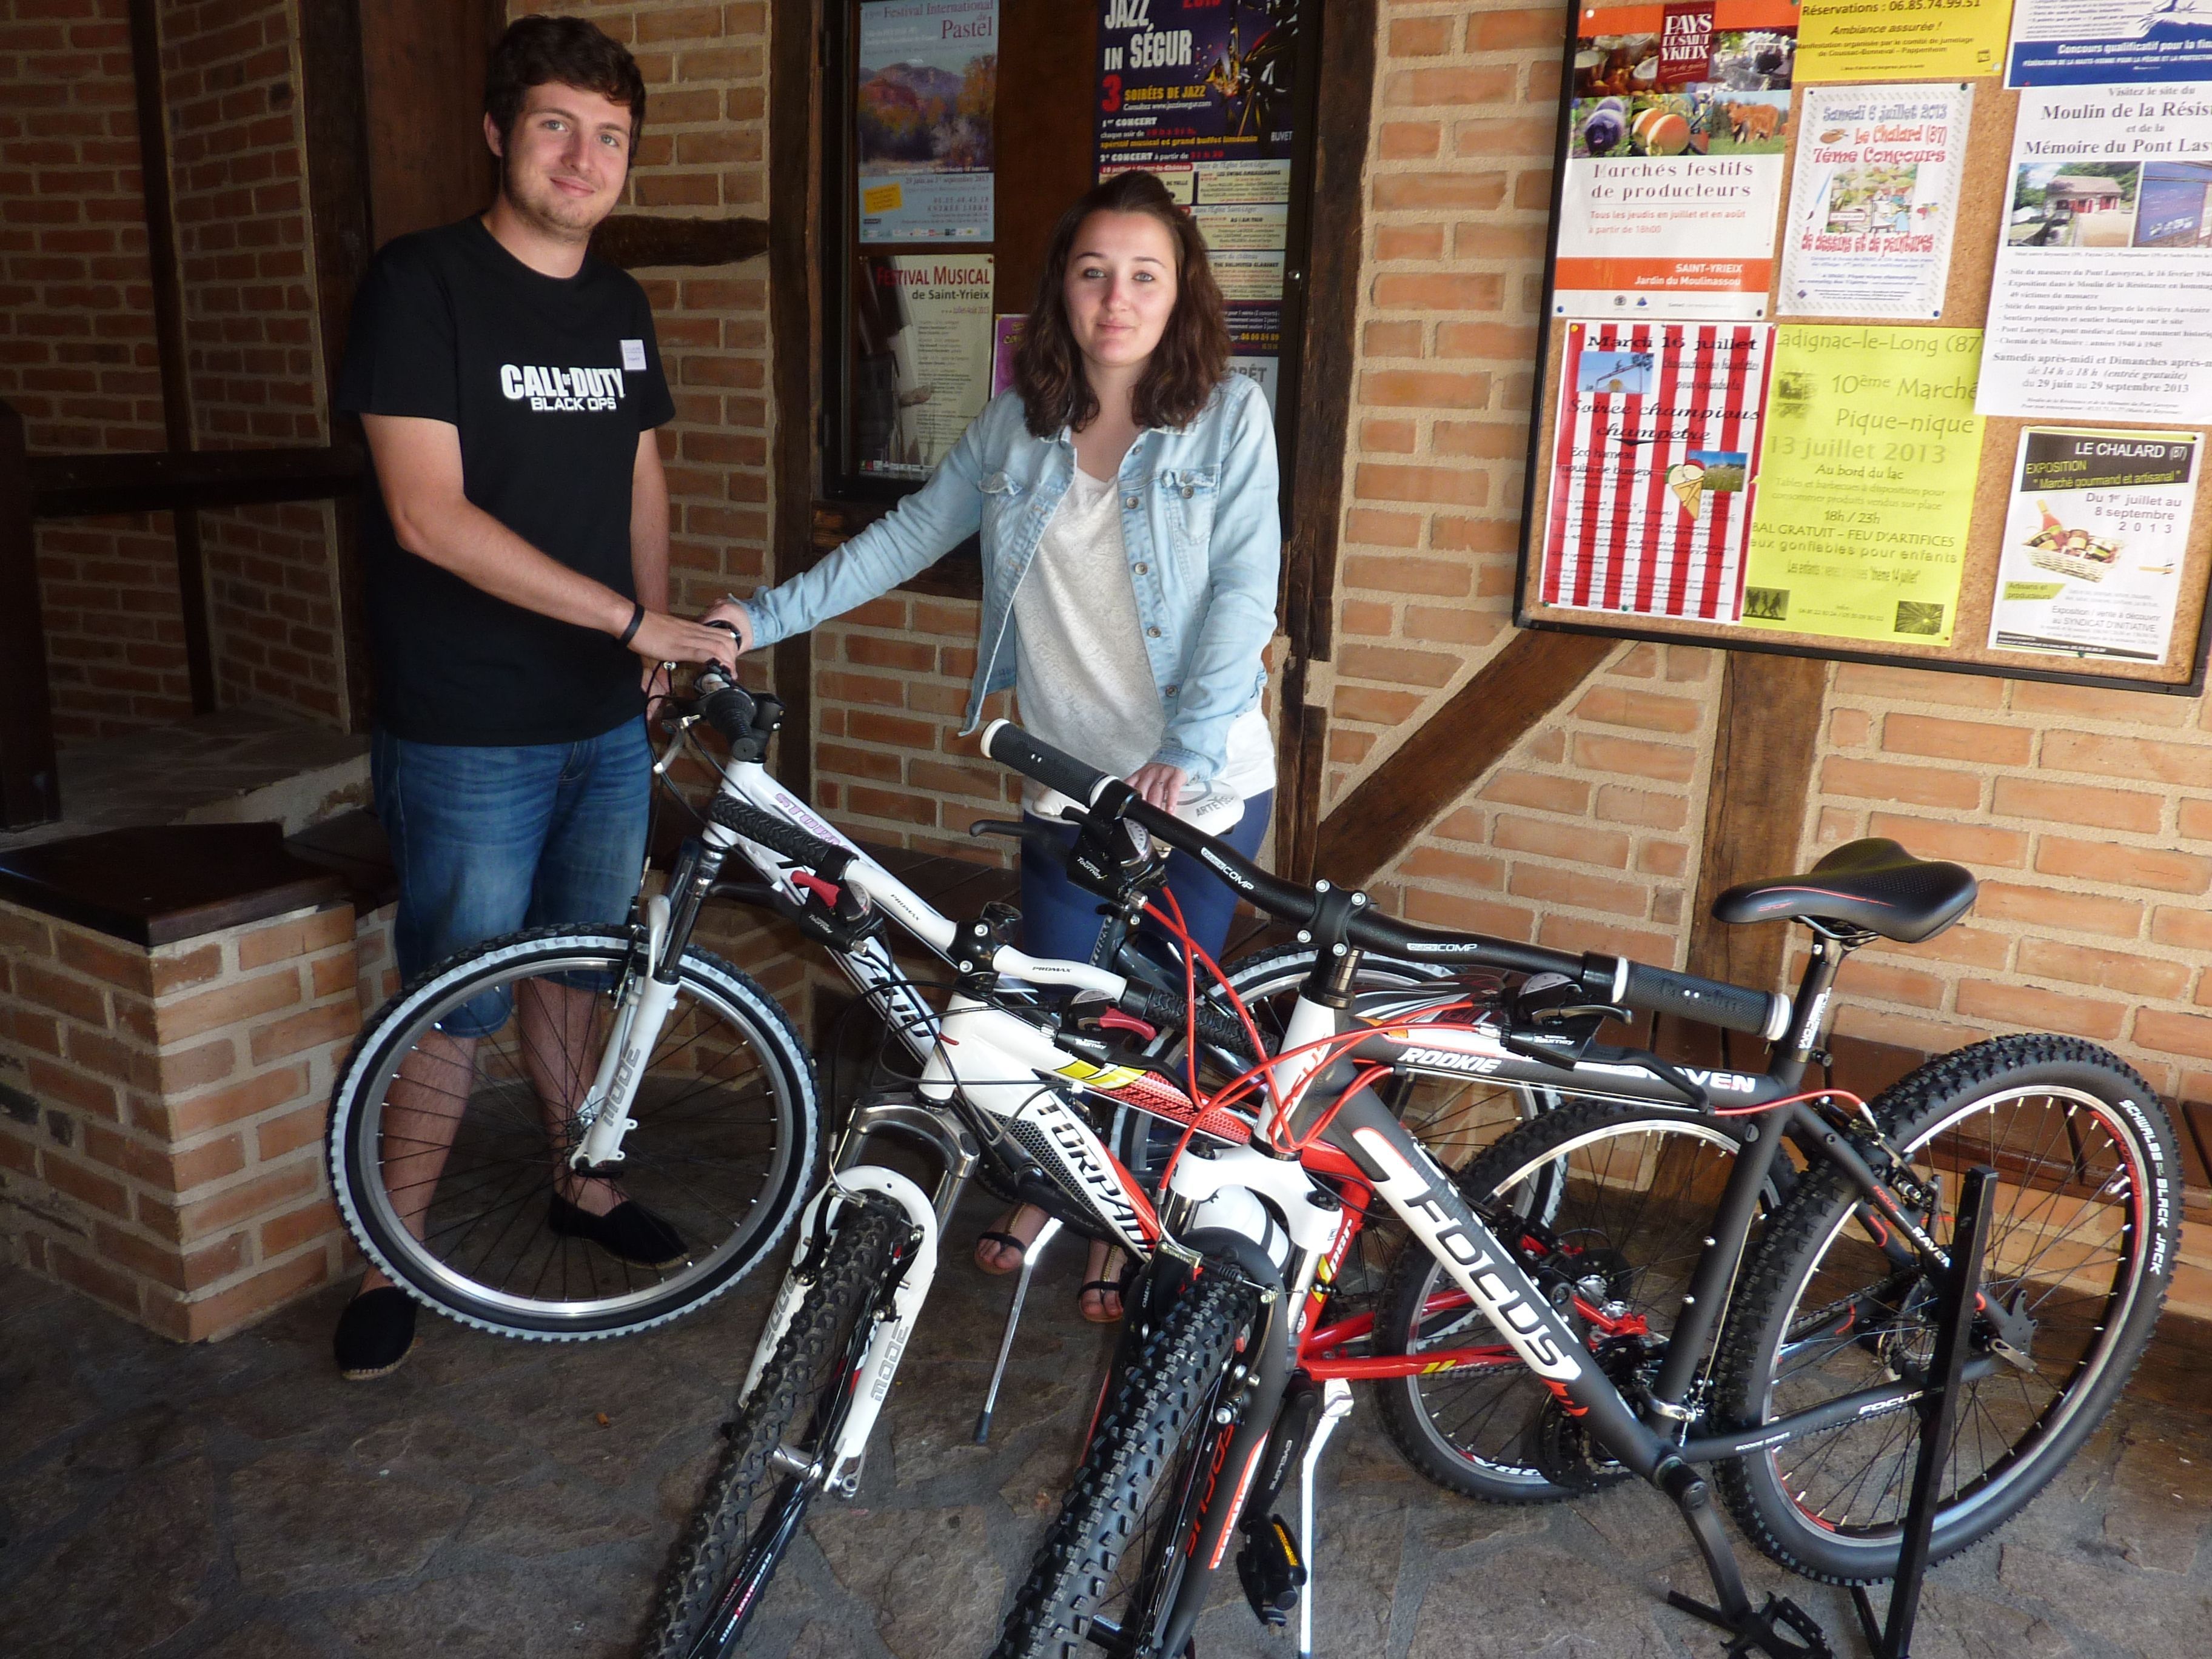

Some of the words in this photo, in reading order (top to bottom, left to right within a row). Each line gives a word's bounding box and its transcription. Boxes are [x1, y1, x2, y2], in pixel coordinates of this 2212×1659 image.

[883, 4, 923, 18] Festival
[927, 0, 993, 15] International
[1104, 0, 1150, 29] JAZZ
[1802, 2, 1878, 16] Réservations
[942, 17, 993, 40] Pastel
[1665, 14, 1712, 35] PAYS
[1830, 24, 1885, 36] Ambiance
[1891, 22, 1935, 33] assurée
[1104, 47, 1123, 70] IN
[1130, 22, 1192, 69] SÉGUR
[1661, 45, 1709, 61] YRIEIX
[2057, 44, 2102, 55] Concours
[2160, 41, 2182, 52] pour
[2184, 39, 2195, 50] la
[1101, 74, 1122, 113] 3
[1124, 85, 1164, 101] SOIRÉES
[1167, 86, 1181, 99] DE
[1182, 85, 1206, 99] JAZZ
[2108, 87, 2144, 96] Visitez
[2159, 87, 2180, 95] site
[2182, 85, 2195, 95] du
[1823, 104, 1865, 122] Samedi
[1879, 104, 1918, 122] juillet
[1920, 104, 1947, 119] 2013
[2041, 104, 2105, 120] Moulin
[2112, 103, 2134, 118] de
[2139, 102, 2155, 118] la
[1115, 116, 1158, 127] CONCERT
[2126, 124, 2136, 133] et
[1873, 124, 1922, 143] Chalard
[2023, 140, 2099, 155] Mémoire
[2105, 139, 2125, 153] du
[2133, 139, 2172, 153] Pont
[1111, 152, 1153, 161] CONCERT
[1593, 163, 1677, 178] Marchés
[1686, 161, 1754, 176] festifs
[1591, 184, 1614, 198] de
[1623, 183, 1751, 201] producteurs
[1627, 211, 1654, 220] jeudis
[1669, 210, 1697, 220] juillet
[1596, 226, 1620, 235] partir
[1636, 225, 1662, 233] 18h00
[876, 266, 930, 286] FESTIVAL
[934, 266, 990, 286] MUSICAL
[1675, 263, 1742, 273] SAINT-YRIEIX
[1635, 276, 1665, 286] Jardin
[1666, 276, 1678, 286] du
[1680, 276, 1741, 286] Moulinassou
[912, 289, 925, 300] de
[928, 289, 990, 300] Saint-Yrieix
[1587, 336, 1653, 348] Mardi
[1661, 335, 1684, 348] 16
[1694, 336, 1758, 351] juillet
[1776, 329, 1938, 357] adignac-le-Long
[1993, 352, 2034, 362] Samedis
[2039, 354, 2094, 366] après-midi
[2096, 356, 2106, 364] et
[2109, 355, 2167, 367] Dimanches
[500, 364, 569, 400] CALL
[569, 367, 625, 399] DUTY
[2042, 367, 2054, 376] 14
[2104, 368, 2140, 379] (entrée
[2142, 370, 2188, 381] gratuite)
[1831, 374, 1891, 395] 10ème
[1897, 376, 1978, 400] Marché
[2037, 378, 2049, 388] 29
[2051, 380, 2073, 391] juin
[2090, 381, 2103, 390] 29
[2106, 381, 2161, 394] septembre
[2163, 384, 2189, 394] 2013
[531, 397, 585, 411] BLACK
[587, 397, 617, 410] OPS
[1567, 398, 1632, 415] Soirée
[1835, 408, 1974, 440] Pique-nique
[1571, 447, 1589, 457] Eco
[1594, 448, 1635, 460] hameau
[1769, 435, 1796, 455] 13
[1800, 437, 1874, 460] juillet
[1883, 443, 1947, 464] 2013
[2076, 442, 2094, 455] LE
[2096, 443, 2165, 457] CHALARD
[2169, 446, 2187, 461] (87)
[1815, 464, 1835, 476] Au
[1838, 466, 1865, 478] bord
[1868, 467, 1884, 478] du
[1887, 467, 1904, 480] lac
[2026, 460, 2087, 474] EXPOSITION
[2040, 478, 2073, 489] Marché
[2074, 475, 2120, 489] gourmand
[2123, 474, 2133, 483] et
[2134, 472, 2174, 484] artisanal
[2086, 492, 2103, 504] Du
[2124, 494, 2161, 507] juillet
[2165, 497, 2182, 507] au
[1825, 509, 1845, 521] 18h
[1858, 512, 1880, 525] 23h
[2094, 506, 2102, 517] 8
[2106, 509, 2174, 521] septembre
[1752, 524, 1775, 534] BAL
[1778, 525, 1835, 538] GRATUIT
[1847, 529, 1873, 540] FEU
[1876, 531, 1955, 547] D'ARTIFICES
[1780, 540, 1855, 555] gonflables
[1861, 548, 1894, 559] pour
[1902, 549, 1958, 563] enfants
[2052, 605, 2090, 617] Exposition
[2063, 617, 2104, 629] SYNDICAT
[1077, 856, 1106, 880] Tourney
[1032, 965, 1072, 974] PROMAX
[1397, 1047, 1503, 1073] ROOKIE
[2119, 1099, 2164, 1162] SCHWALBE
[2156, 1178, 2170, 1228] BLACK
[2149, 1232, 2168, 1275] JACK
[1403, 1193, 1567, 1366] FOCUS
[1858, 1390, 1924, 1415] FOCUS
